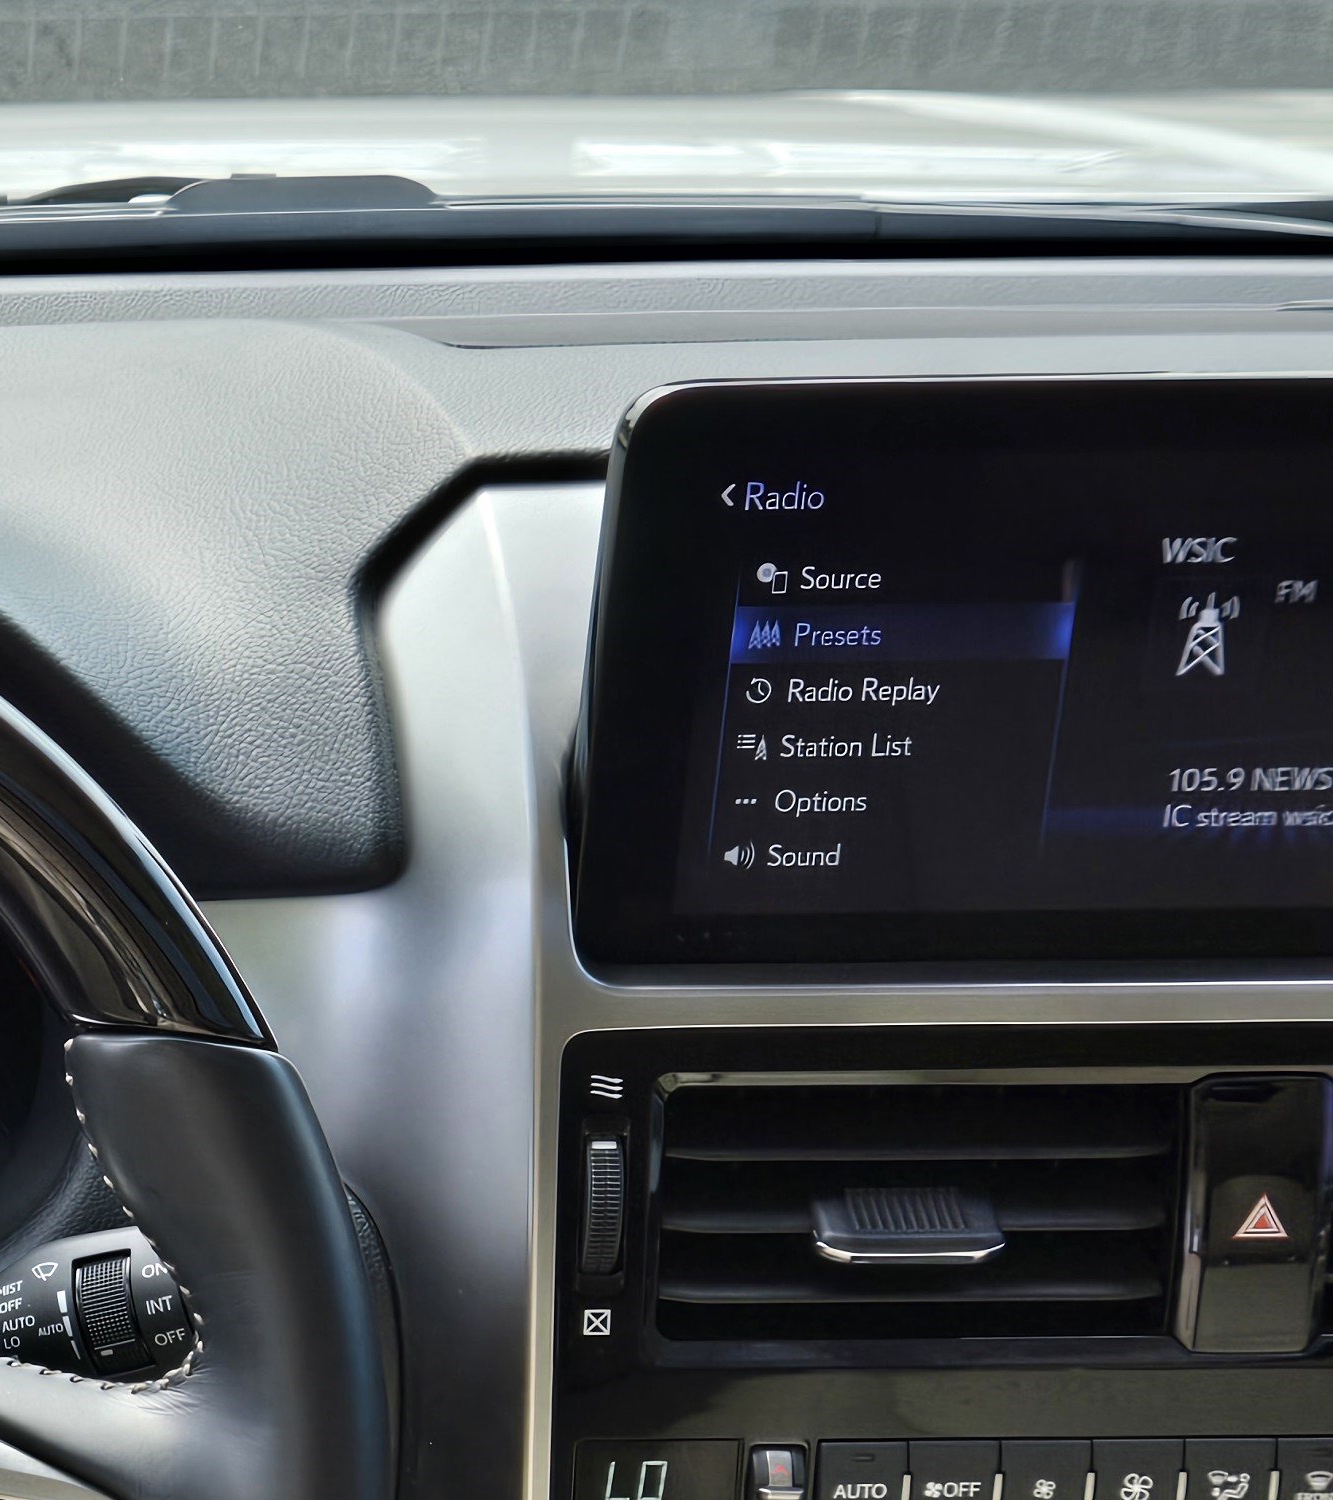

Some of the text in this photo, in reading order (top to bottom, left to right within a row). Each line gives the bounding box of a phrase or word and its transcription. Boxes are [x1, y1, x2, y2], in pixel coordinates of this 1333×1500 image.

[744, 480, 825, 511] Radio
[1162, 536, 1238, 564] WSIC
[800, 565, 882, 590] Source
[1275, 579, 1318, 603] FM
[794, 622, 882, 647] Presets
[787, 676, 941, 707] Radio Replay
[779, 732, 913, 758] Station List
[1169, 767, 1246, 792] 105.9
[774, 789, 868, 818] Options
[1163, 804, 1192, 828] IC
[1195, 808, 1277, 827] stream
[766, 842, 842, 867] Sound
[0, 1299, 23, 1313] OFF
[146, 1295, 173, 1315] INT
[3, 1315, 36, 1333] AUTO
[38, 1323, 64, 1336] AUTO
[4, 1336, 21, 1349] LO
[154, 1328, 185, 1346] OFF
[832, 1483, 888, 1500] AUTO
[942, 1481, 982, 1498] OFF
